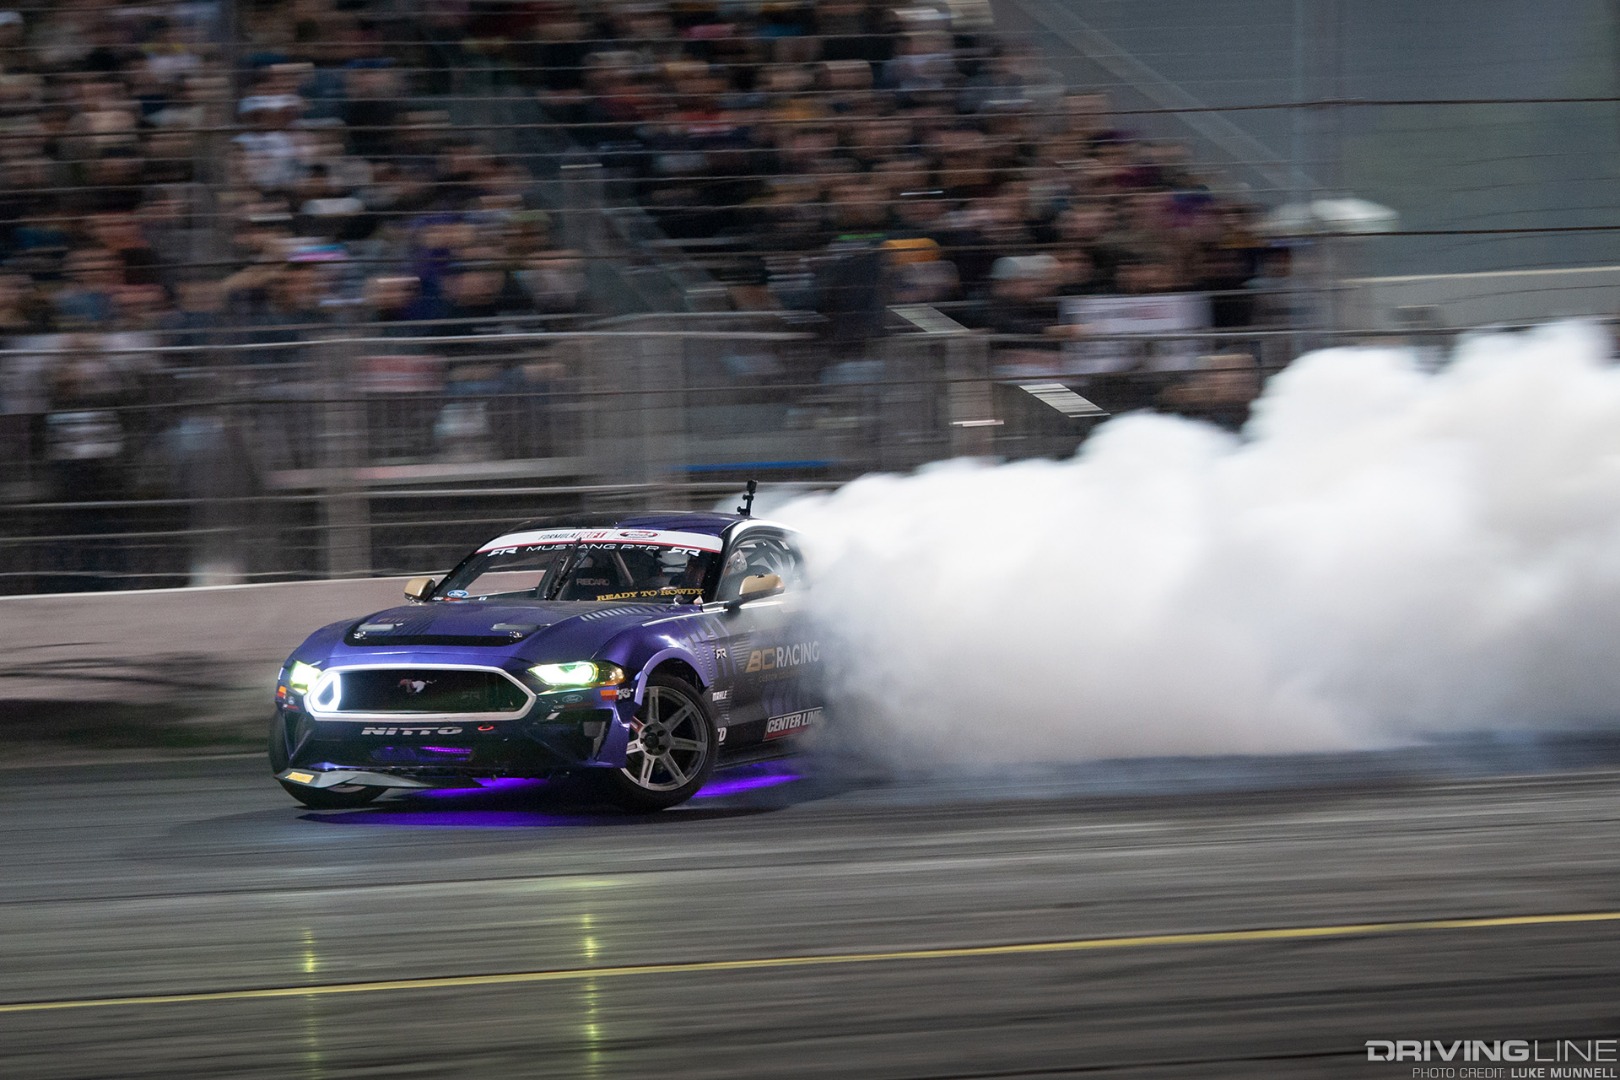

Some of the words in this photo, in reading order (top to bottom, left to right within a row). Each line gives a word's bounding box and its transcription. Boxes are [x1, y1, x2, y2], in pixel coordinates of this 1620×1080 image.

[526, 543, 616, 552] MUSTANG
[596, 591, 639, 601] READY
[660, 588, 704, 596] ROWDY
[776, 641, 820, 668] RACING
[767, 714, 801, 733] CENTER
[361, 727, 463, 735] NITTO
